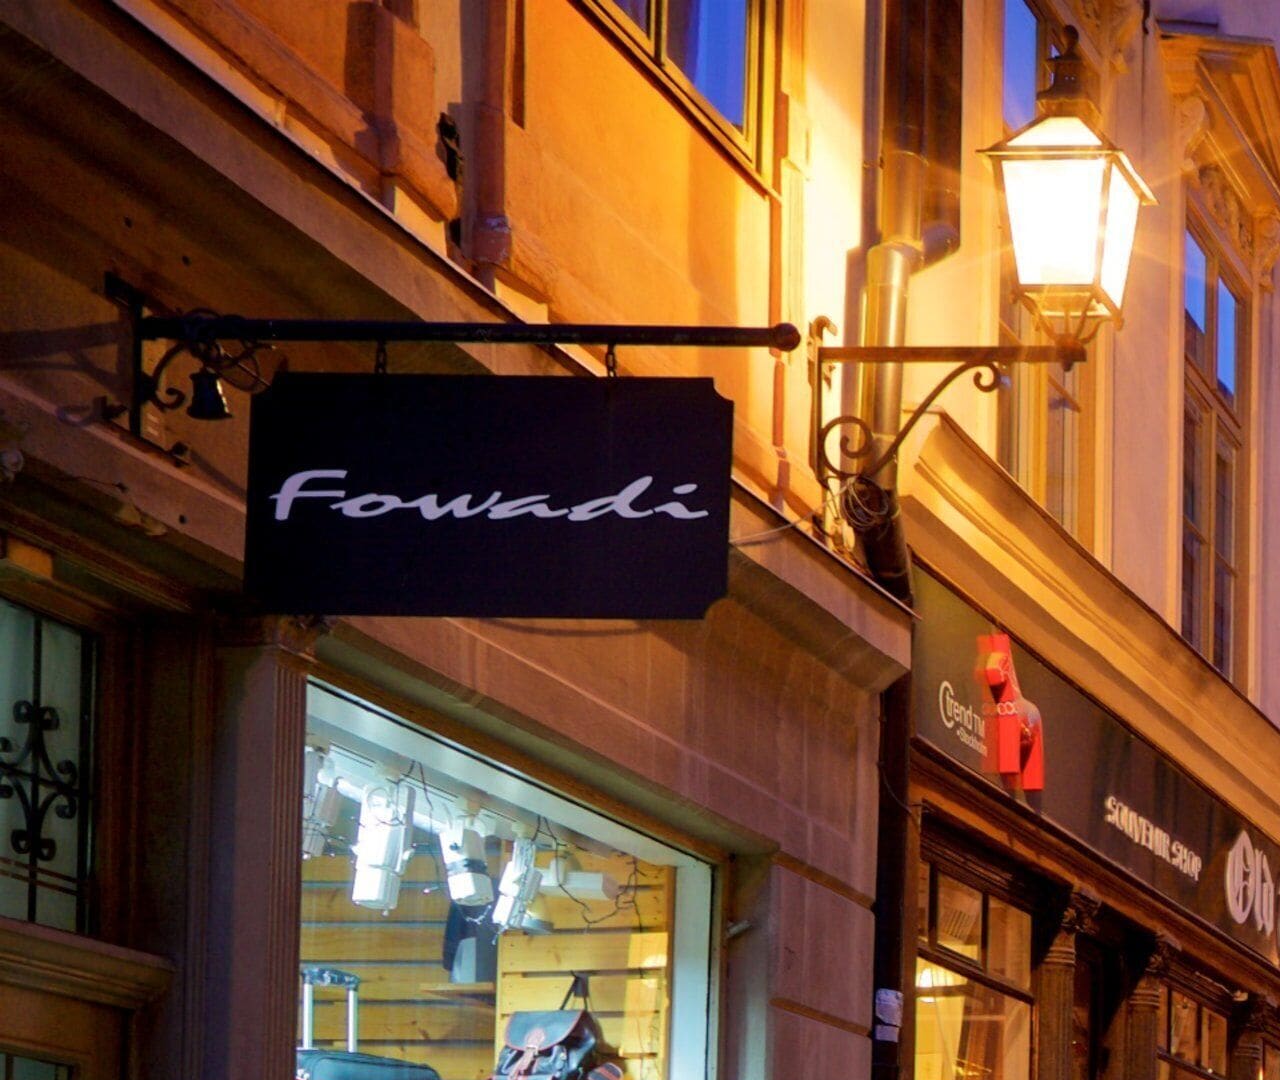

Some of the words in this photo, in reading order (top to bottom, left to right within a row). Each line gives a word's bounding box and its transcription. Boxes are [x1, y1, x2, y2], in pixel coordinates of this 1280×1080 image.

[269, 469, 708, 521] Fowadi
[1104, 796, 1170, 865] SOUVENIR
[1171, 841, 1202, 881] SHOP
[1226, 830, 1274, 937] Old
